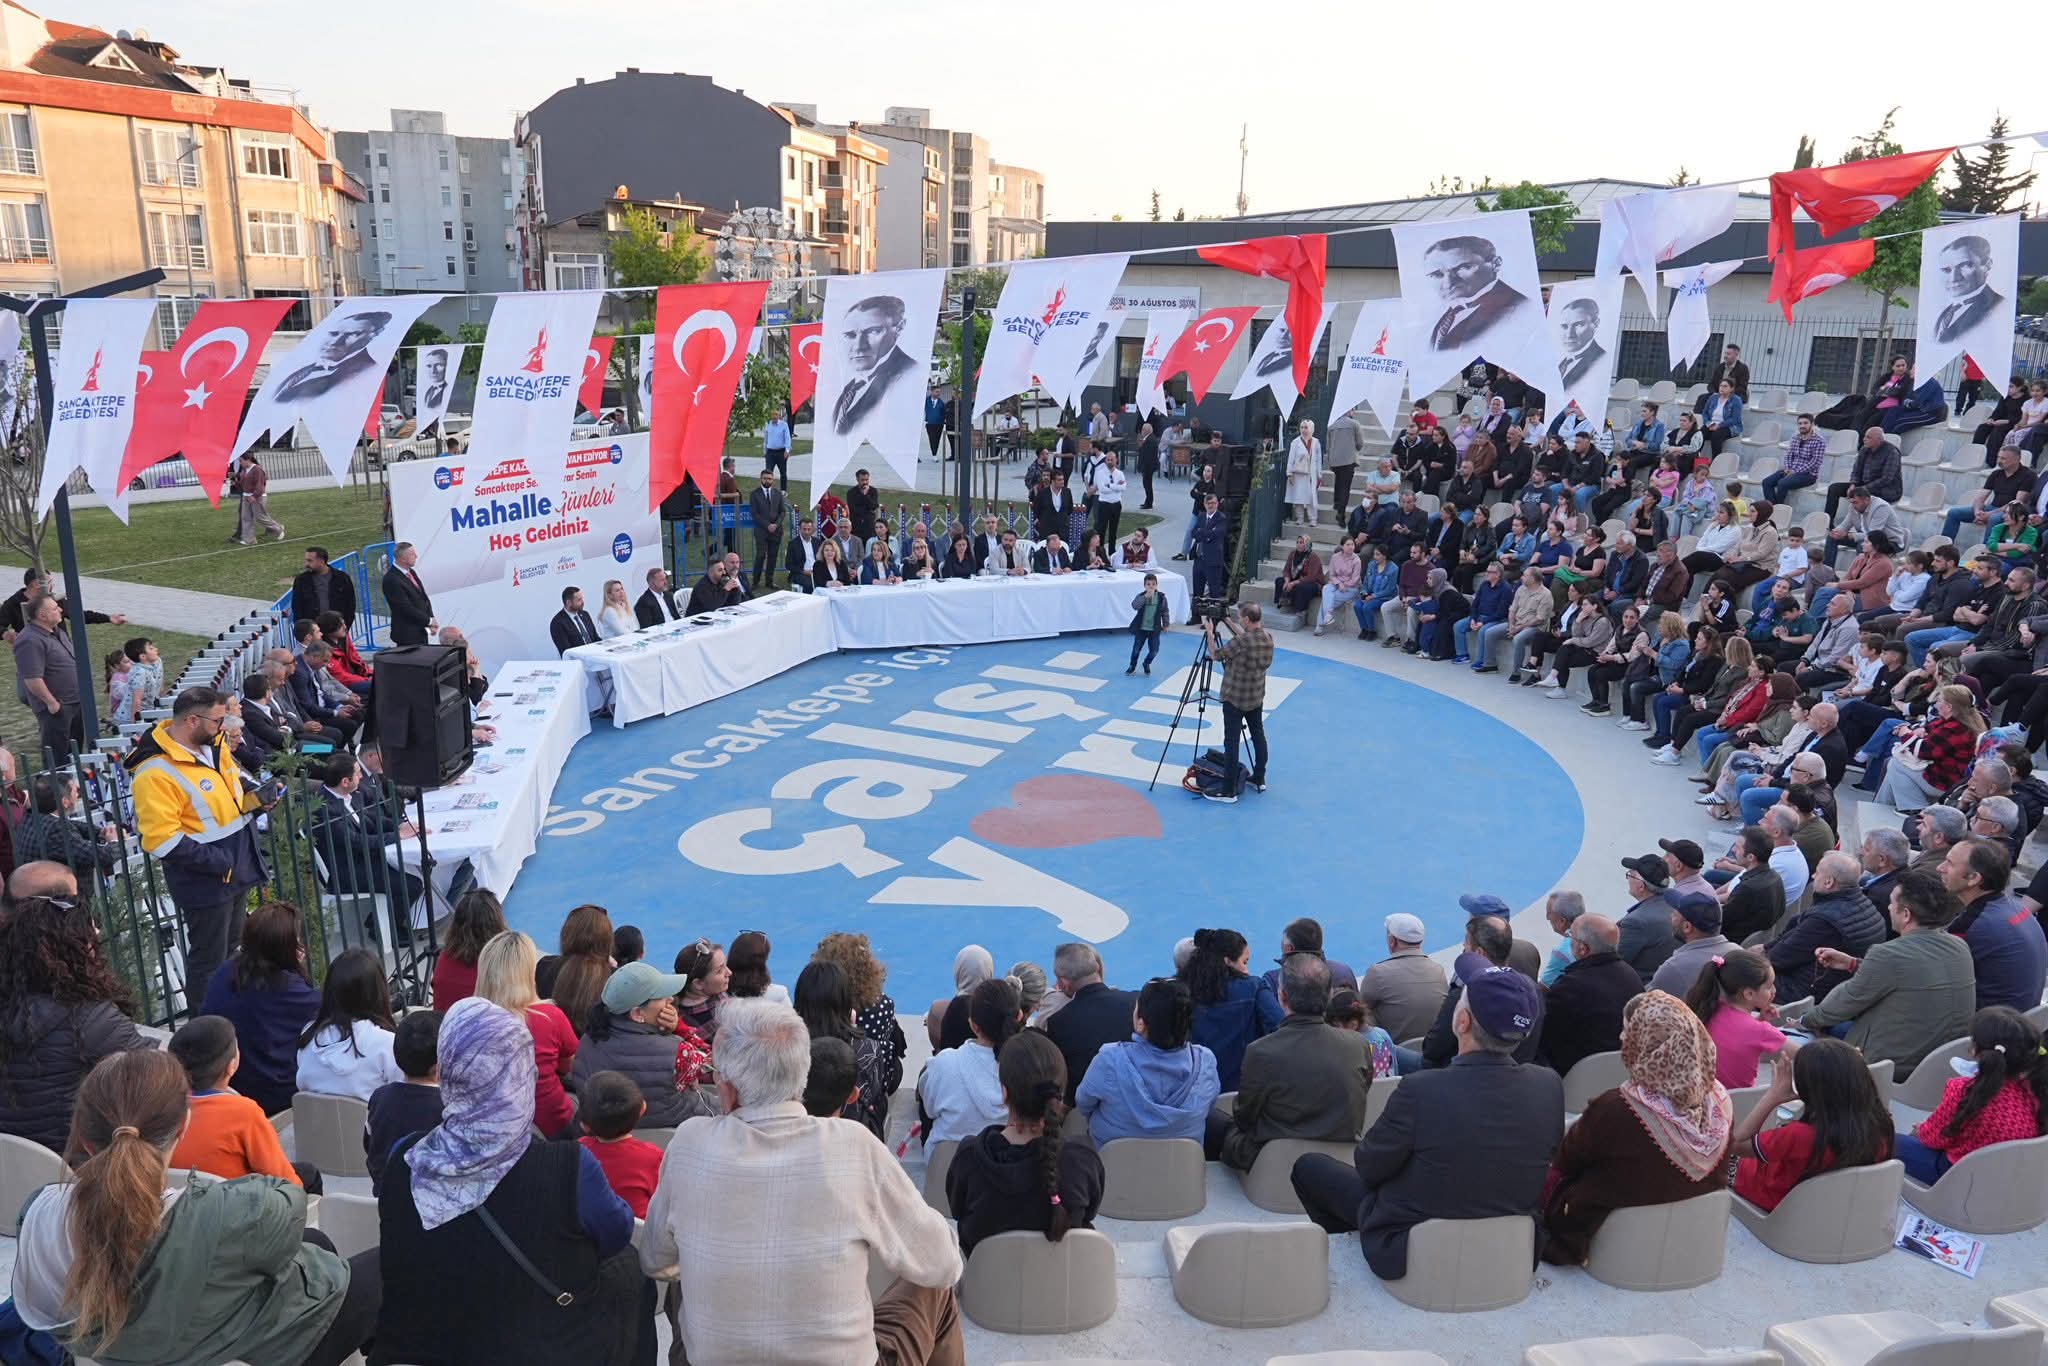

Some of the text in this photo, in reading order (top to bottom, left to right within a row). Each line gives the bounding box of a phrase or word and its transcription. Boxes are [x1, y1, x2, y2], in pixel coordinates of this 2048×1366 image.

[1140, 297, 1177, 307] AĞUSTOS
[475, 482, 525, 496] Sancaktepe
[575, 469, 597, 480] Senin
[451, 493, 551, 531] Mahalle
[489, 516, 590, 552] Hoş Geldiniz
[862, 645, 963, 670] içi
